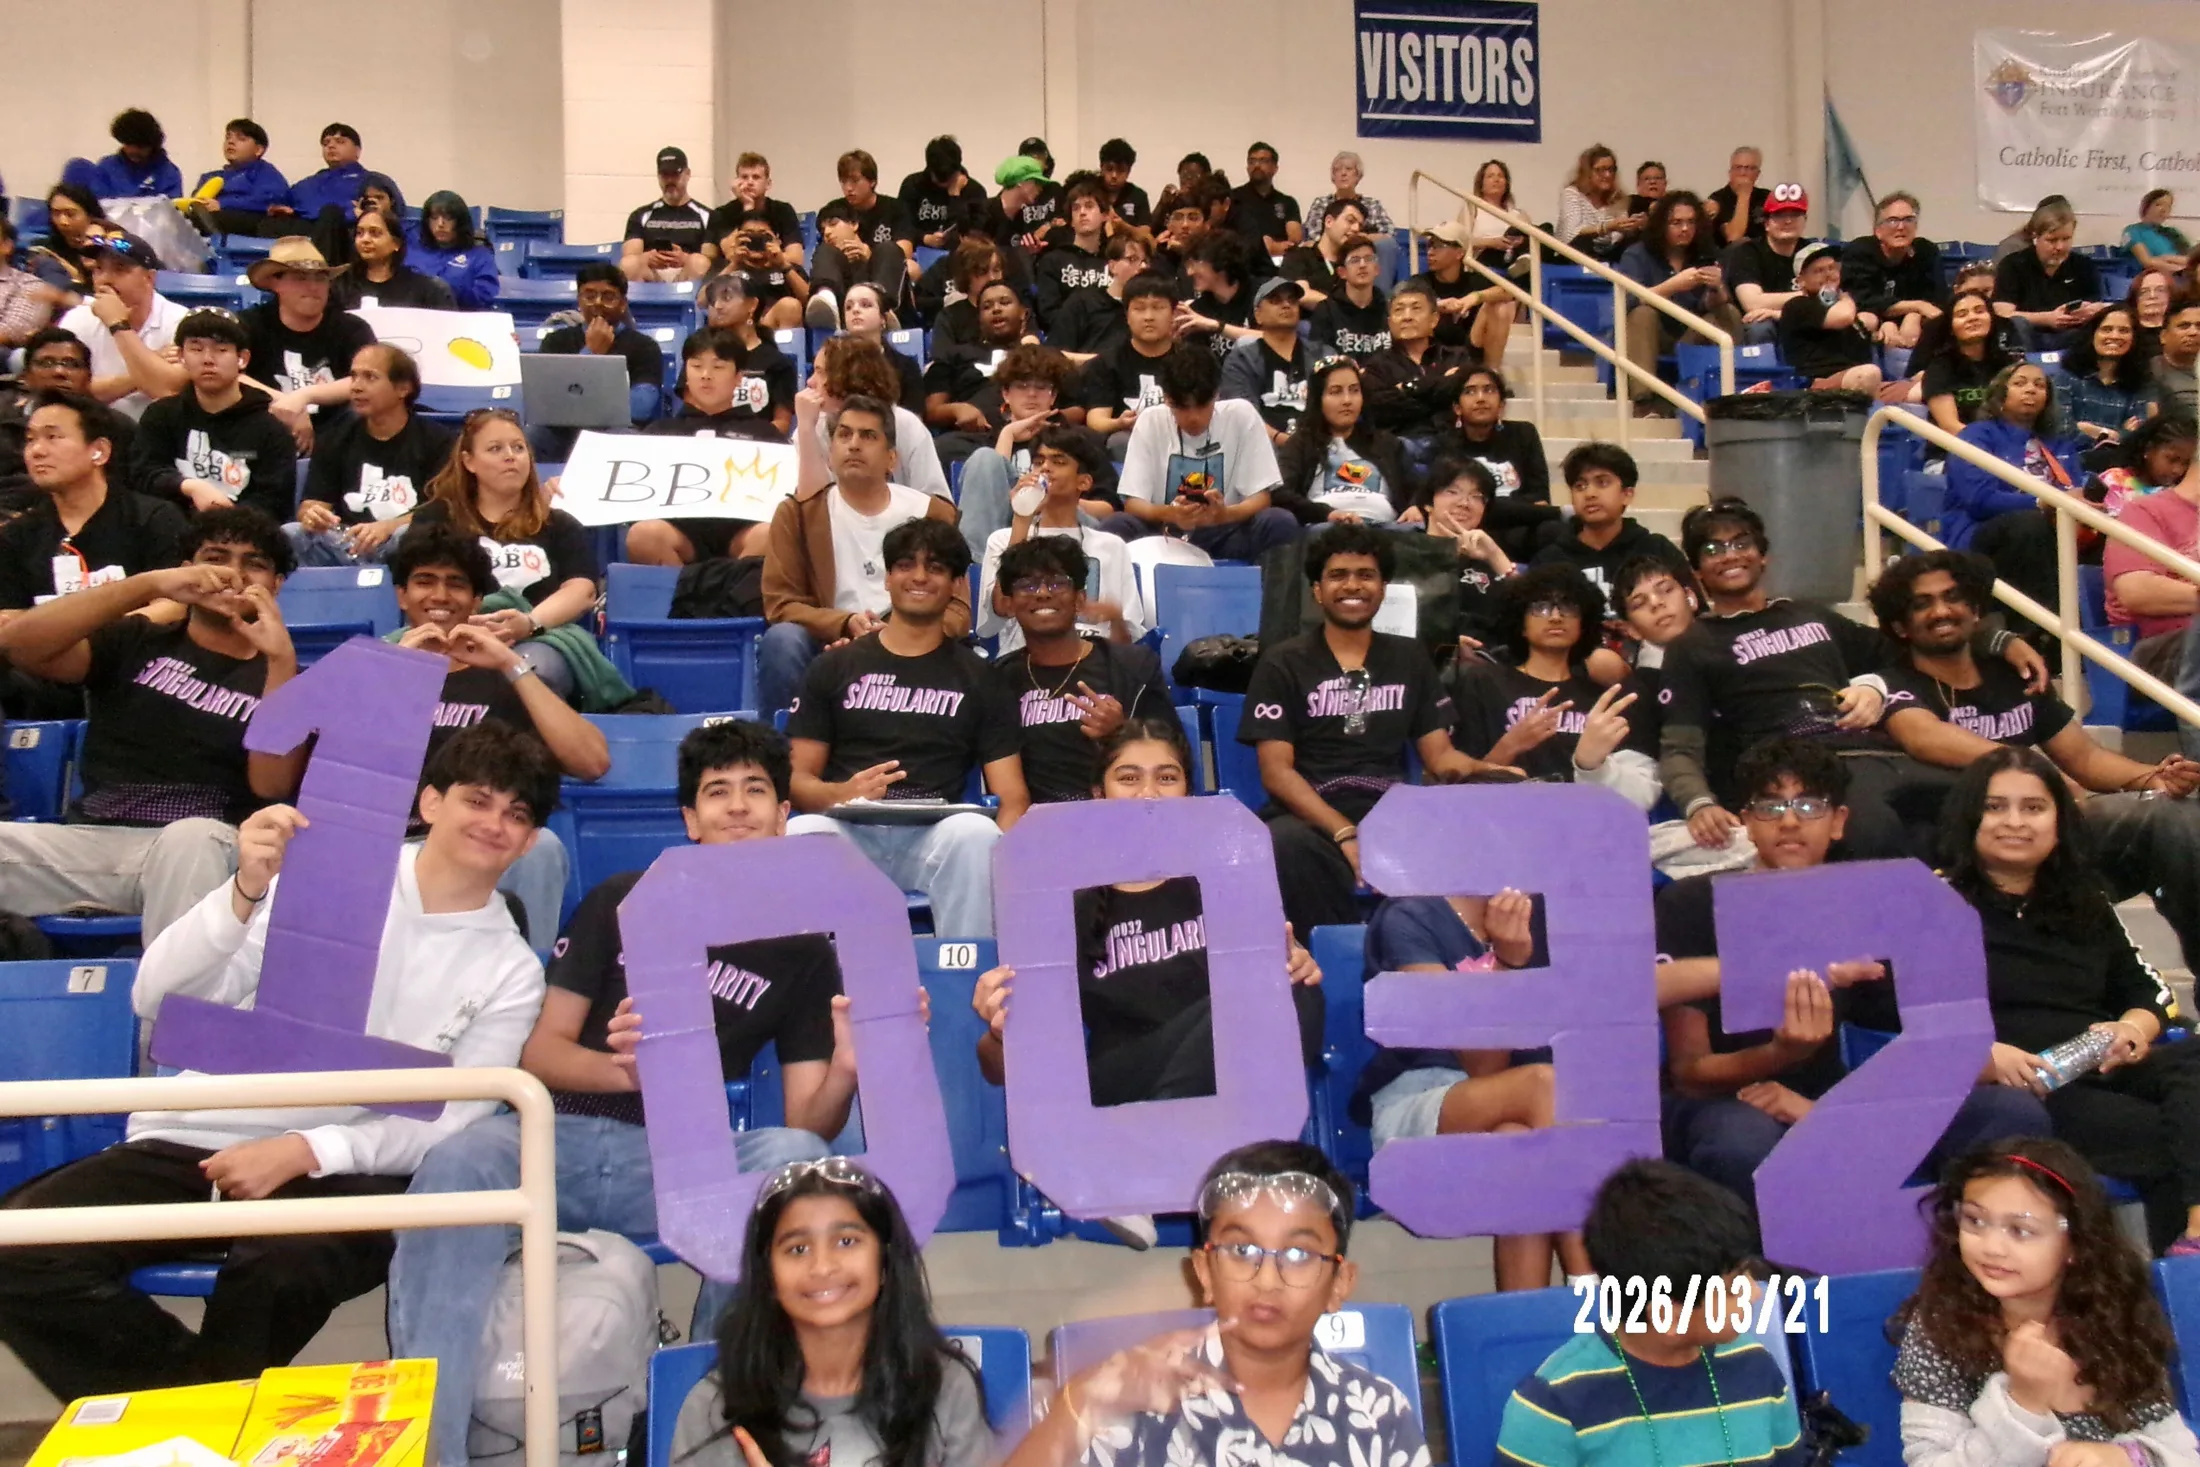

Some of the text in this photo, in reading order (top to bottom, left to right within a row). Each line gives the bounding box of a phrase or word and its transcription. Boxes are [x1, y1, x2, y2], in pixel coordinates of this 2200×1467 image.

[1360, 31, 1535, 107] VISITORS
[1999, 146, 2200, 173] Catholic First, Cathol
[946, 945, 970, 967] 10
[83, 969, 96, 991] 7
[1330, 1315, 1346, 1344] 9
